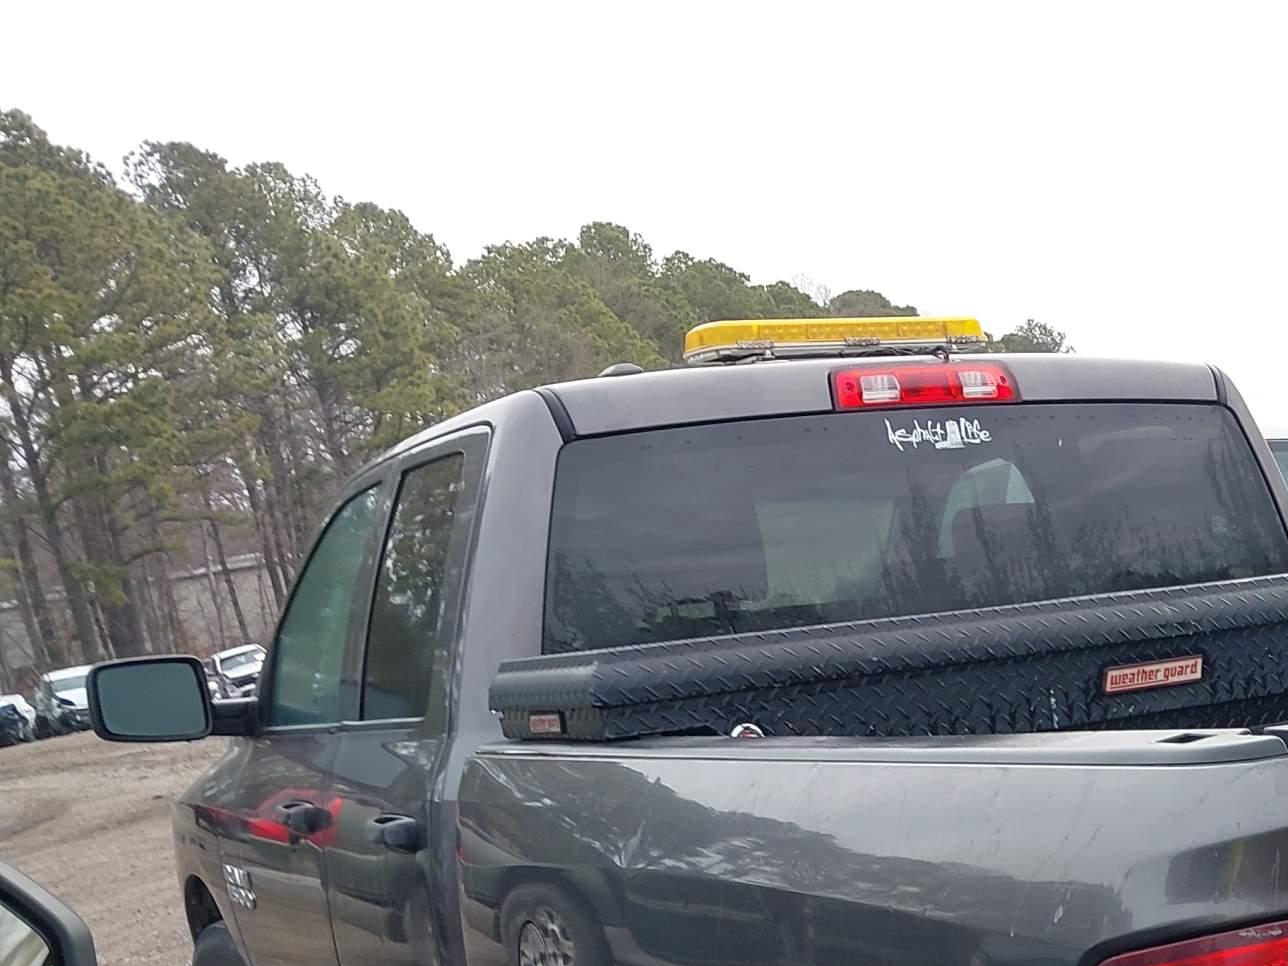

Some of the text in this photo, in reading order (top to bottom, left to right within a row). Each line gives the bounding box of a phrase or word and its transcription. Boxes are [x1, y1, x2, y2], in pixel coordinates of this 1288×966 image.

[960, 417, 992, 444] Life
[1110, 660, 1198, 686] weather guard
